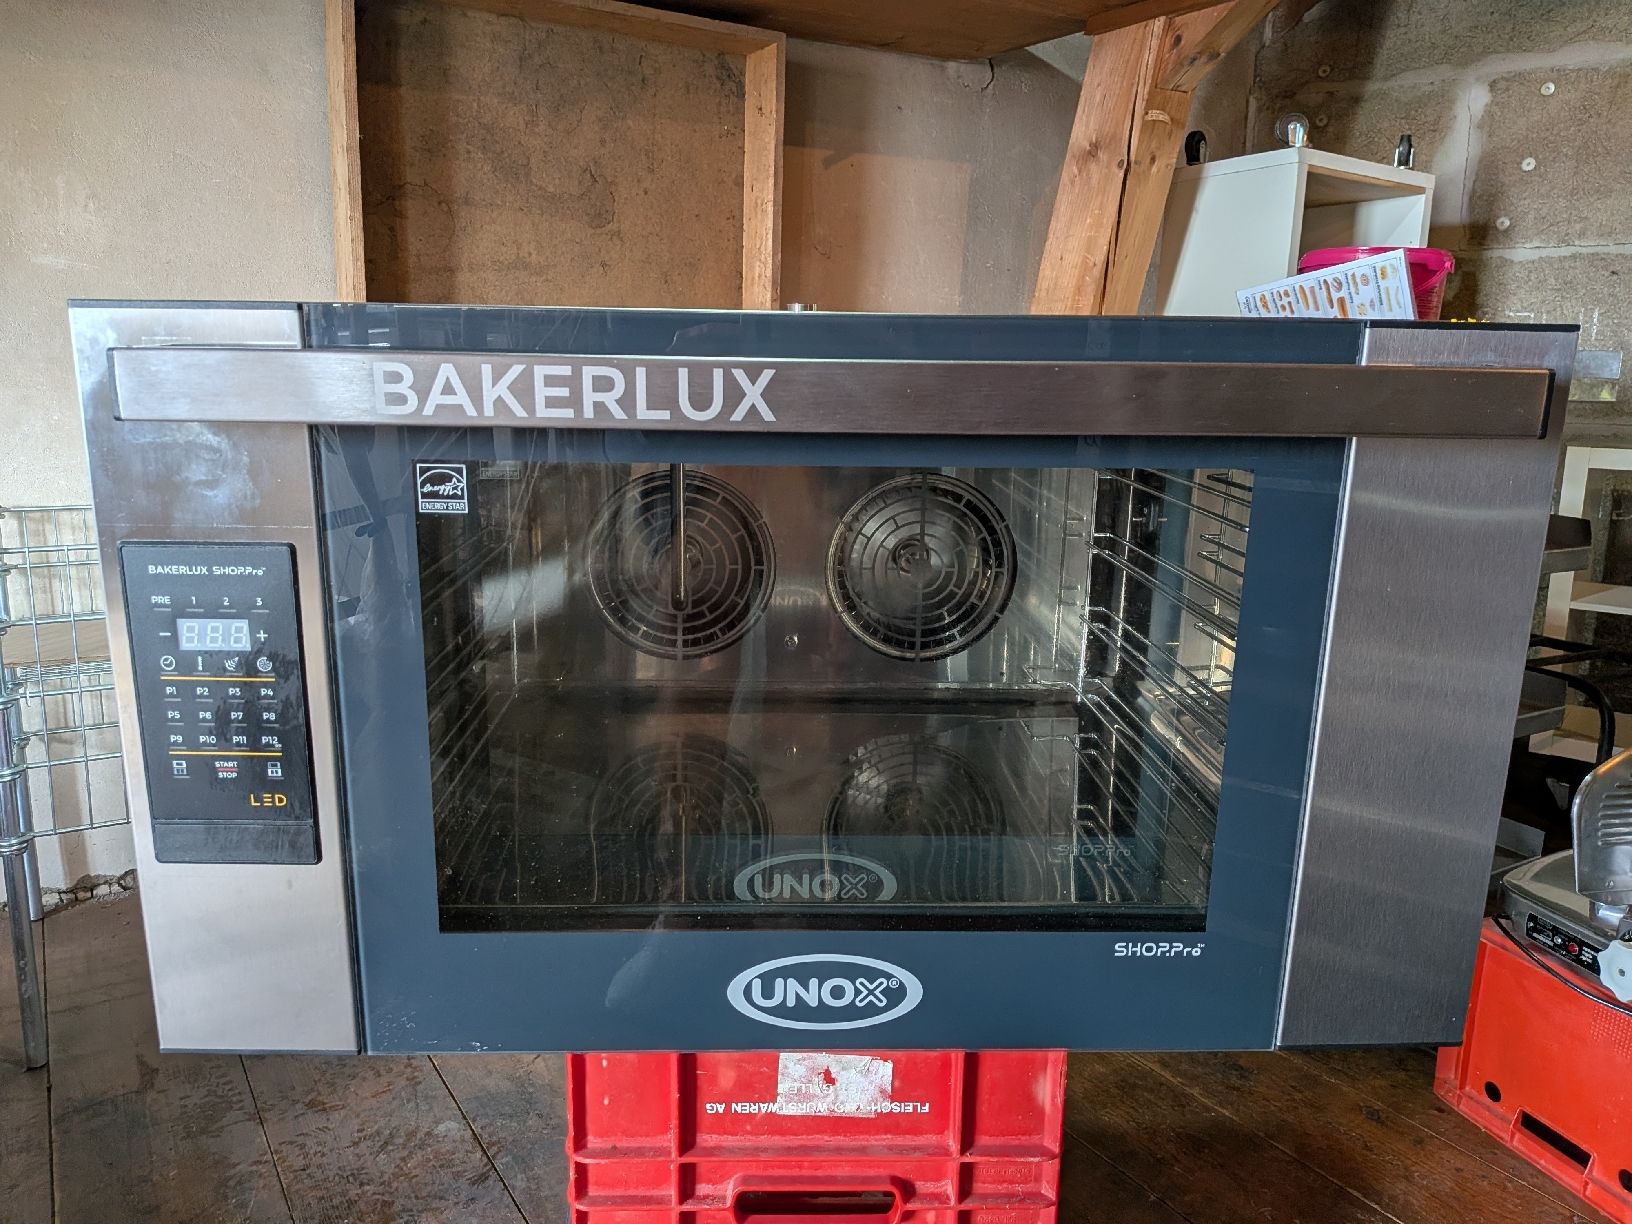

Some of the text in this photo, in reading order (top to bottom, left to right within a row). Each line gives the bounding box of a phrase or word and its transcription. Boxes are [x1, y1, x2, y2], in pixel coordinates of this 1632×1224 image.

[372, 361, 777, 422] BAKERLUX
[422, 502, 465, 510] ENERGY STAR
[148, 565, 208, 575] BAKERLUX
[151, 596, 263, 605] PRE 1 2 3
[228, 688, 241, 696] P3
[260, 688, 274, 696] P4
[168, 711, 180, 719] P5
[231, 712, 243, 720] P7
[263, 712, 276, 720] P8
[170, 735, 278, 744] P9 P10 P11 P12
[251, 794, 287, 806] LED
[706, 1102, 726, 1114] AG
